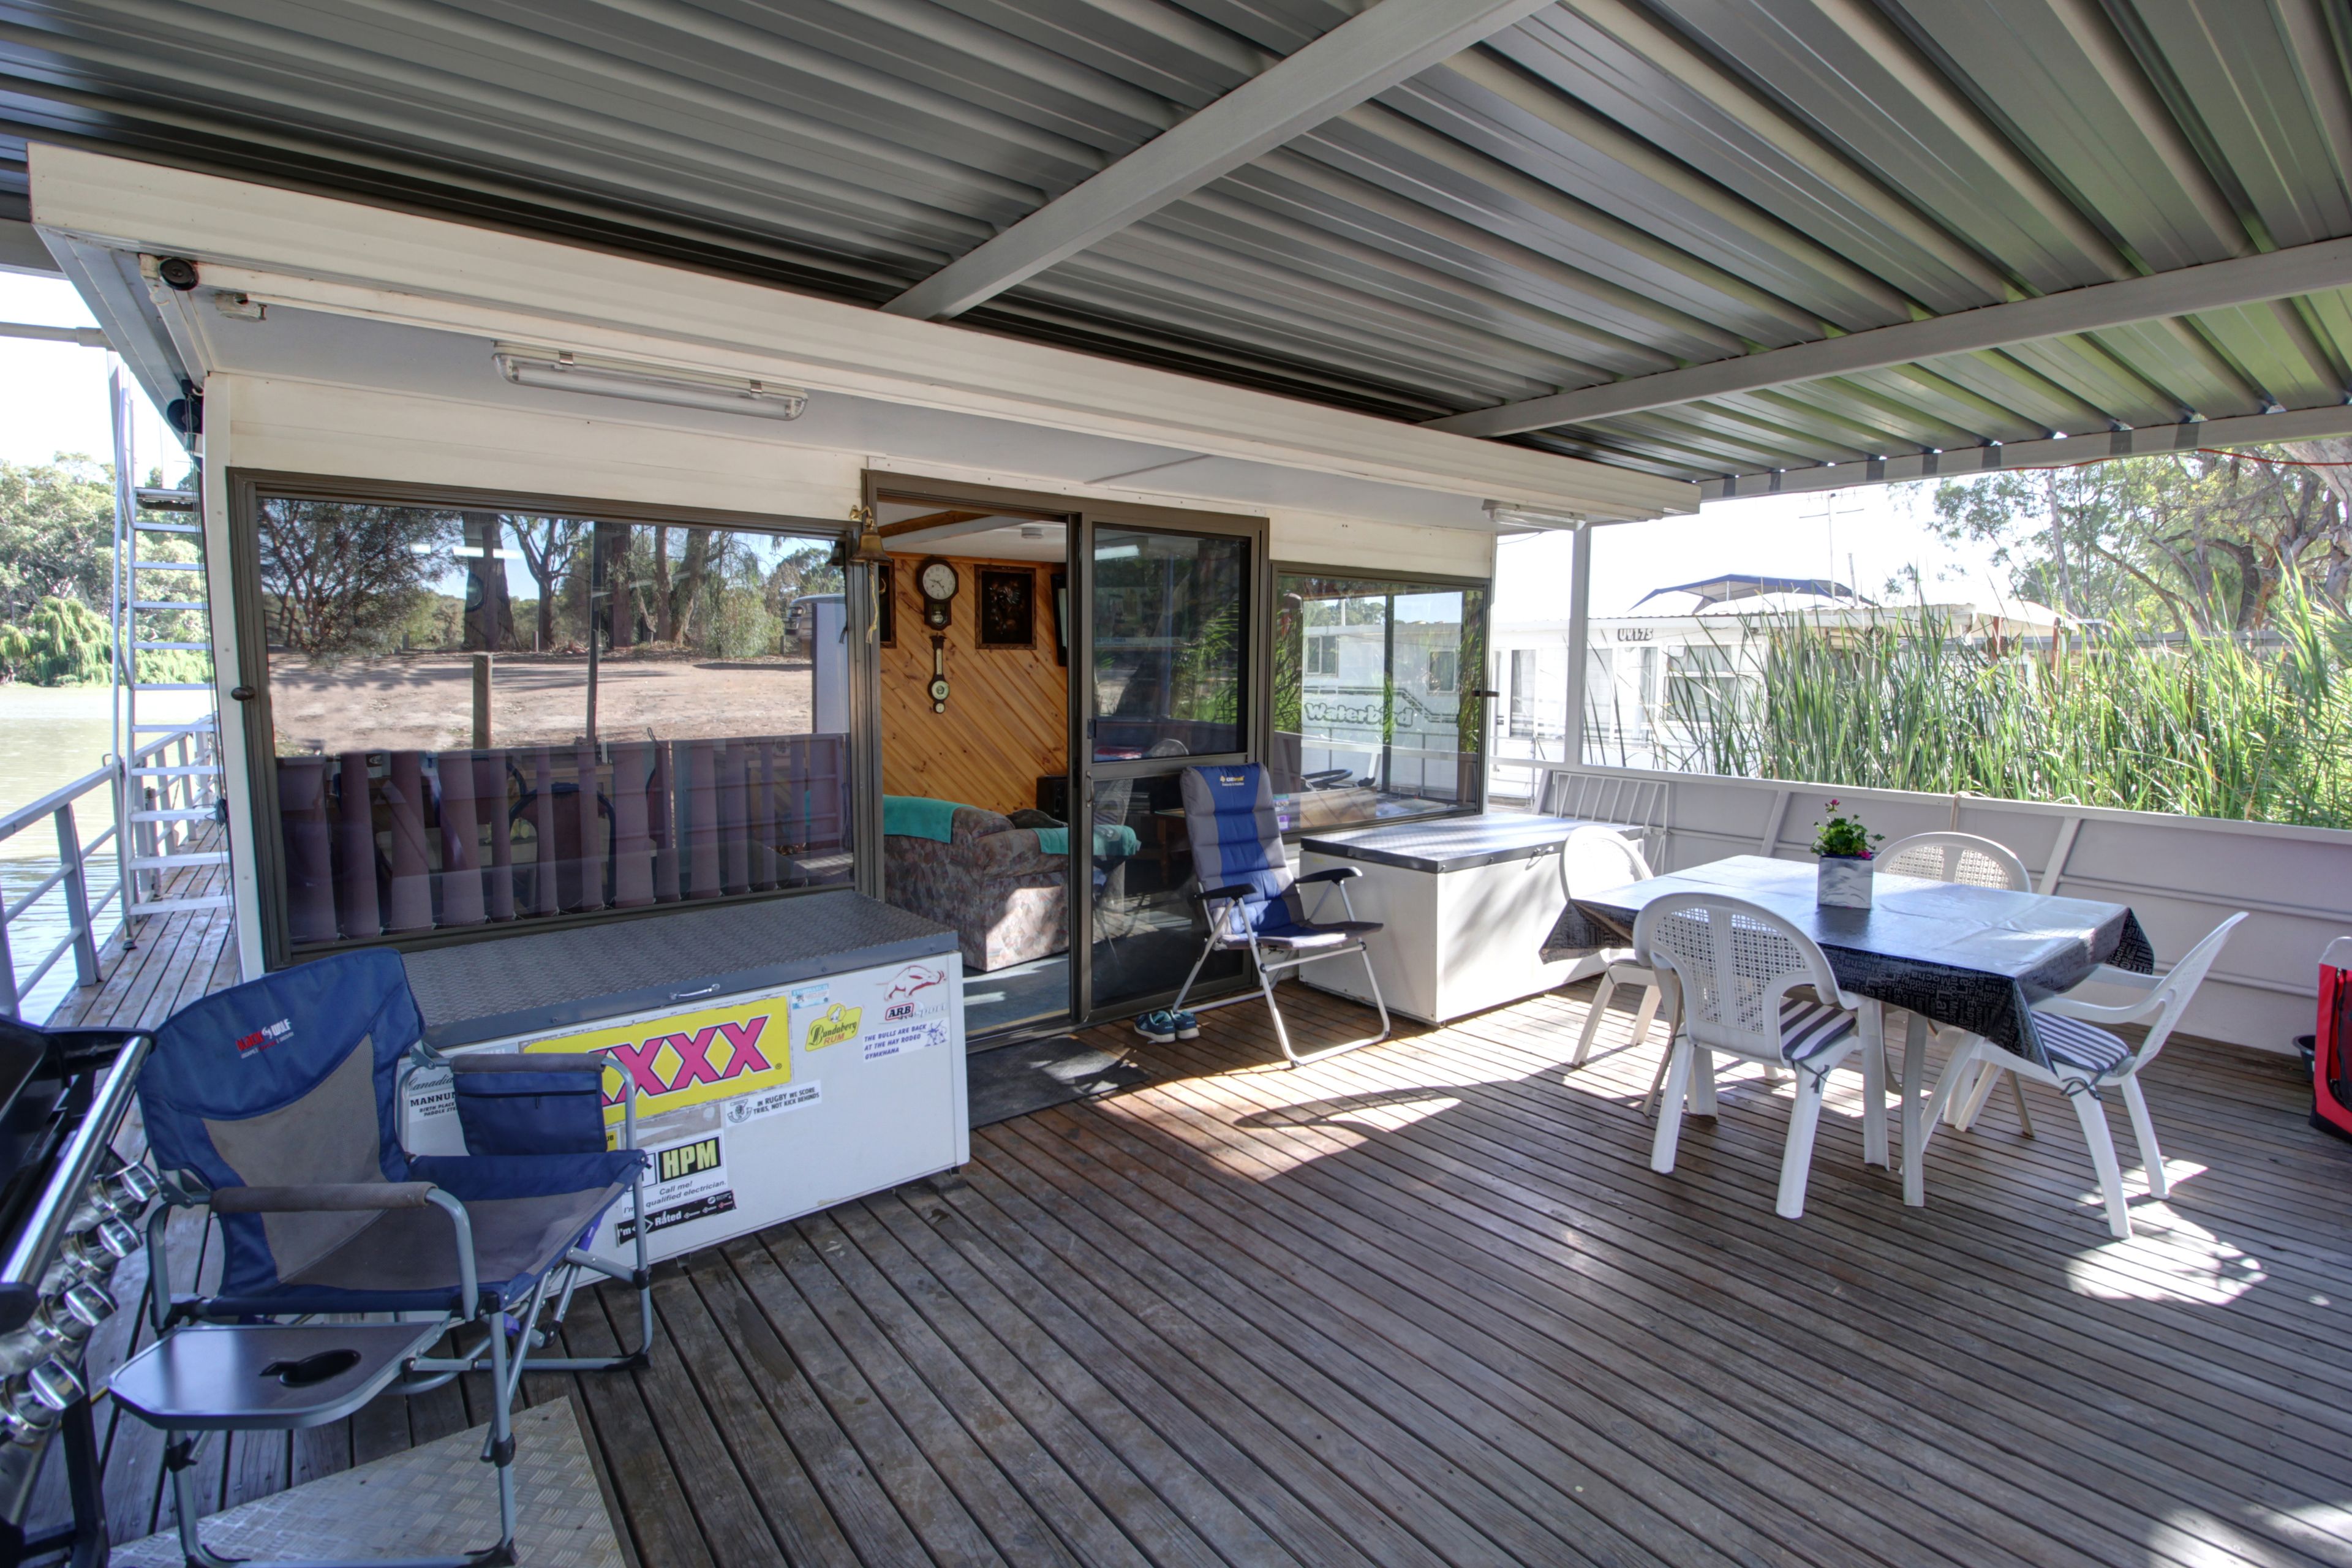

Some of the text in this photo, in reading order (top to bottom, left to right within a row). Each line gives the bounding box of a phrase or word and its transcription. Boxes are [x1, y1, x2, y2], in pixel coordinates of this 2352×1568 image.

[1305, 703, 1414, 728] Waterbd
[1911, 971, 1951, 985] Mocha
[888, 1006, 911, 1018] ARB
[809, 1022, 858, 1046] Bundaberg
[823, 1033, 845, 1045] RUM
[878, 1030, 896, 1039] BULLS
[911, 1023, 927, 1033] BACK
[874, 1041, 886, 1049] THE
[901, 1033, 921, 1043] RODEO
[865, 1047, 900, 1060] GYMKHANA
[409, 1074, 454, 1091] Canadia
[764, 1093, 787, 1104] RUGBY
[799, 1087, 815, 1096] SCORE
[797, 1092, 820, 1102] BEHINDS
[662, 1139, 717, 1180] HPM
[646, 1191, 682, 1208] qualified
[684, 1180, 726, 1196] electrician.
[660, 1180, 693, 1195] Call me!
[617, 1227, 631, 1238] I'm
[655, 1210, 682, 1226] Rated
